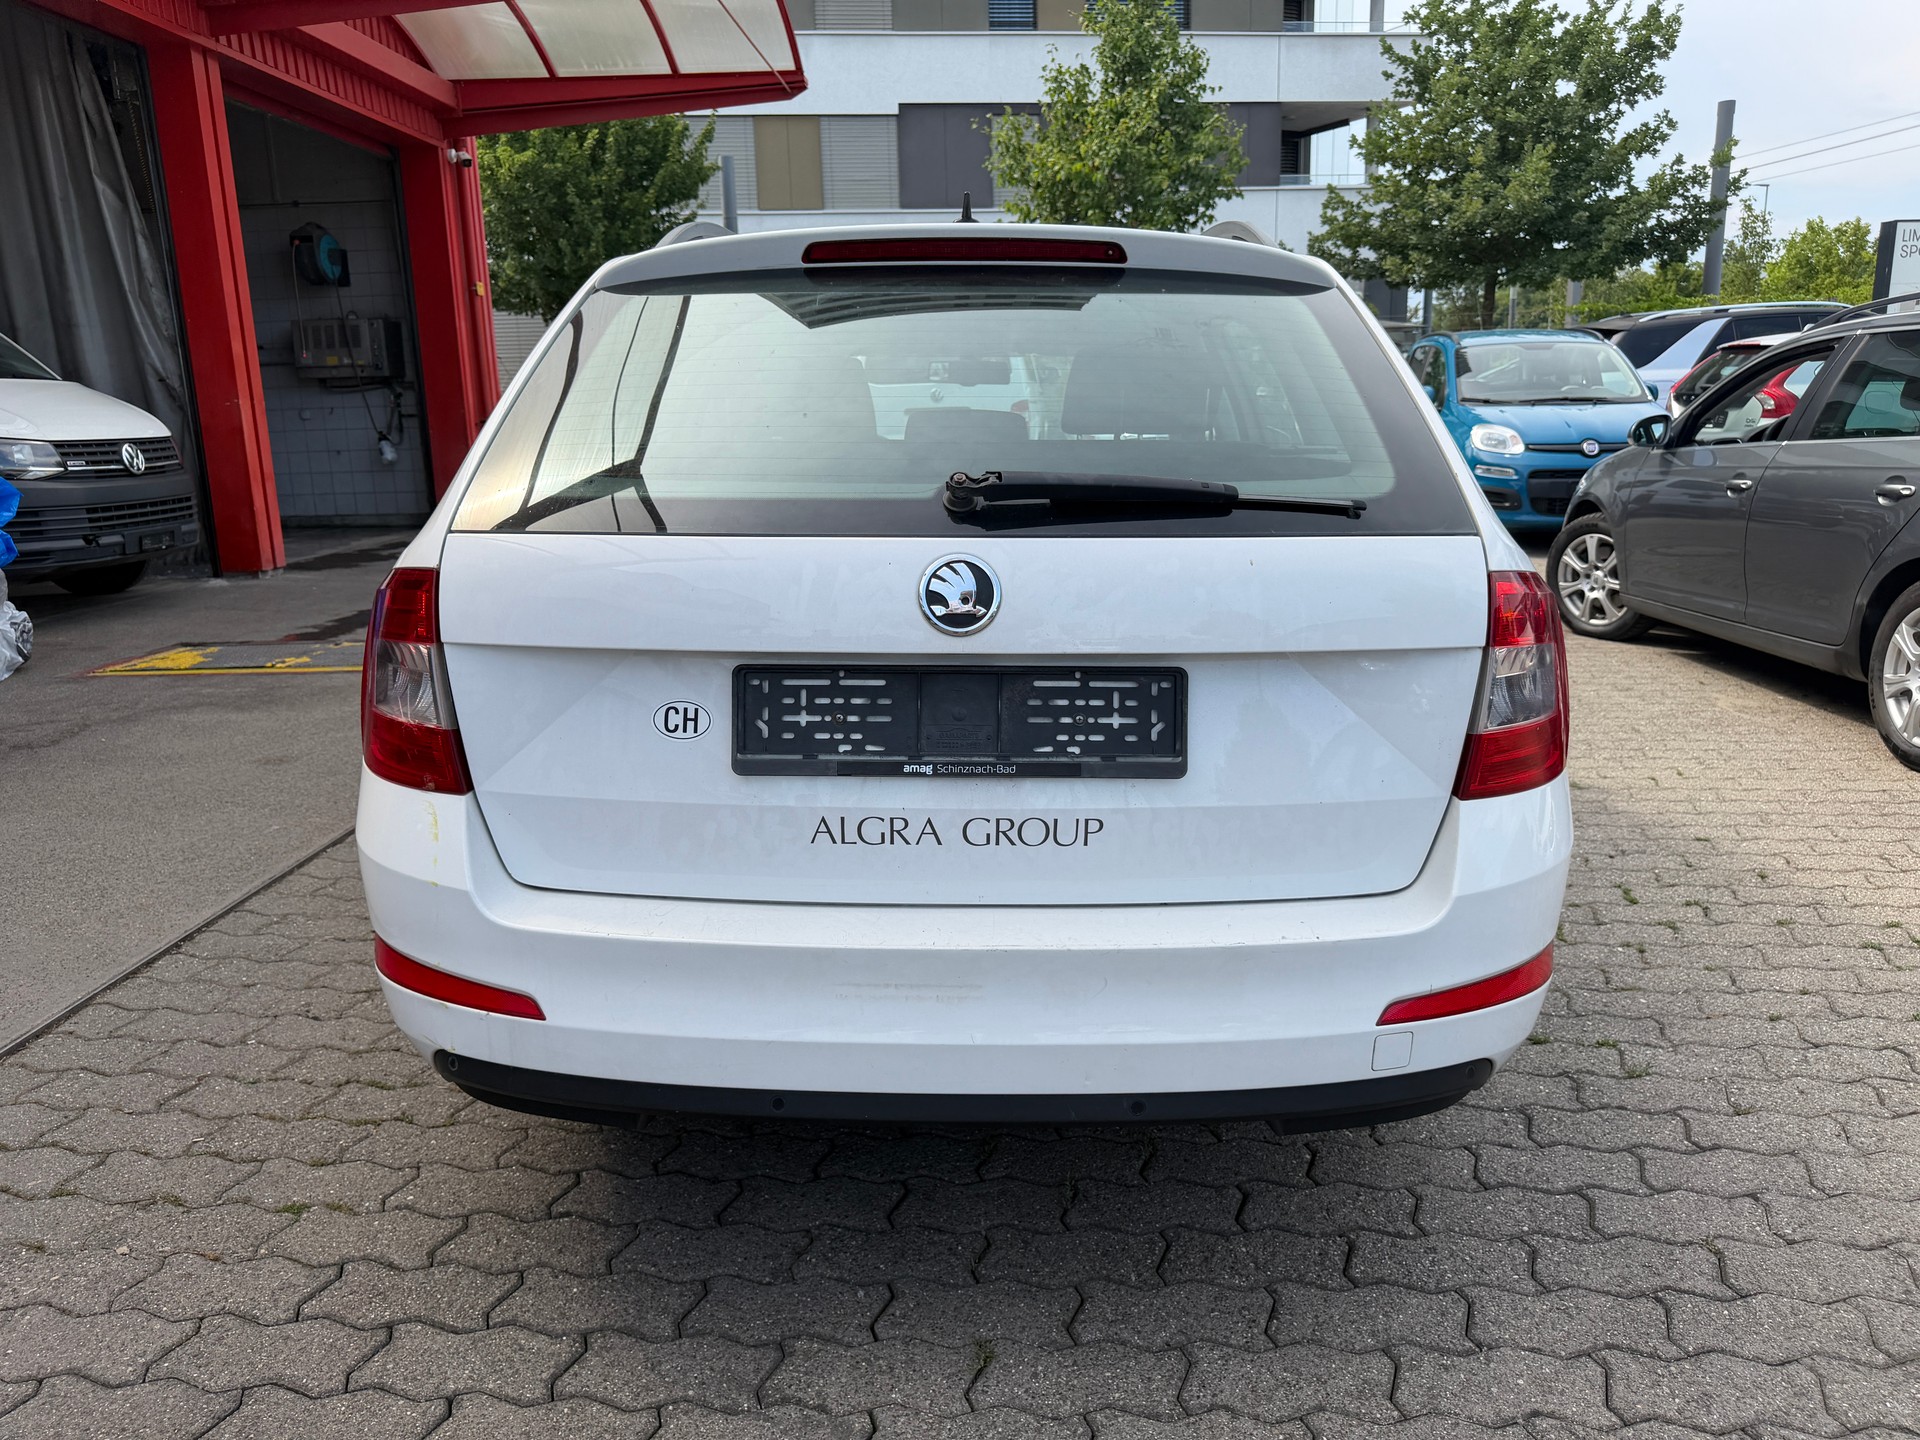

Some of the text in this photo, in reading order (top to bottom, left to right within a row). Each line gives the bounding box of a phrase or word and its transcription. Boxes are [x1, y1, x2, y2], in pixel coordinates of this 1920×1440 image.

[1900, 244, 1920, 258] SP
[664, 706, 699, 733] CH
[903, 764, 1016, 775] amag Schinznach-Bad
[810, 815, 1104, 847] ALGRA GROUP
